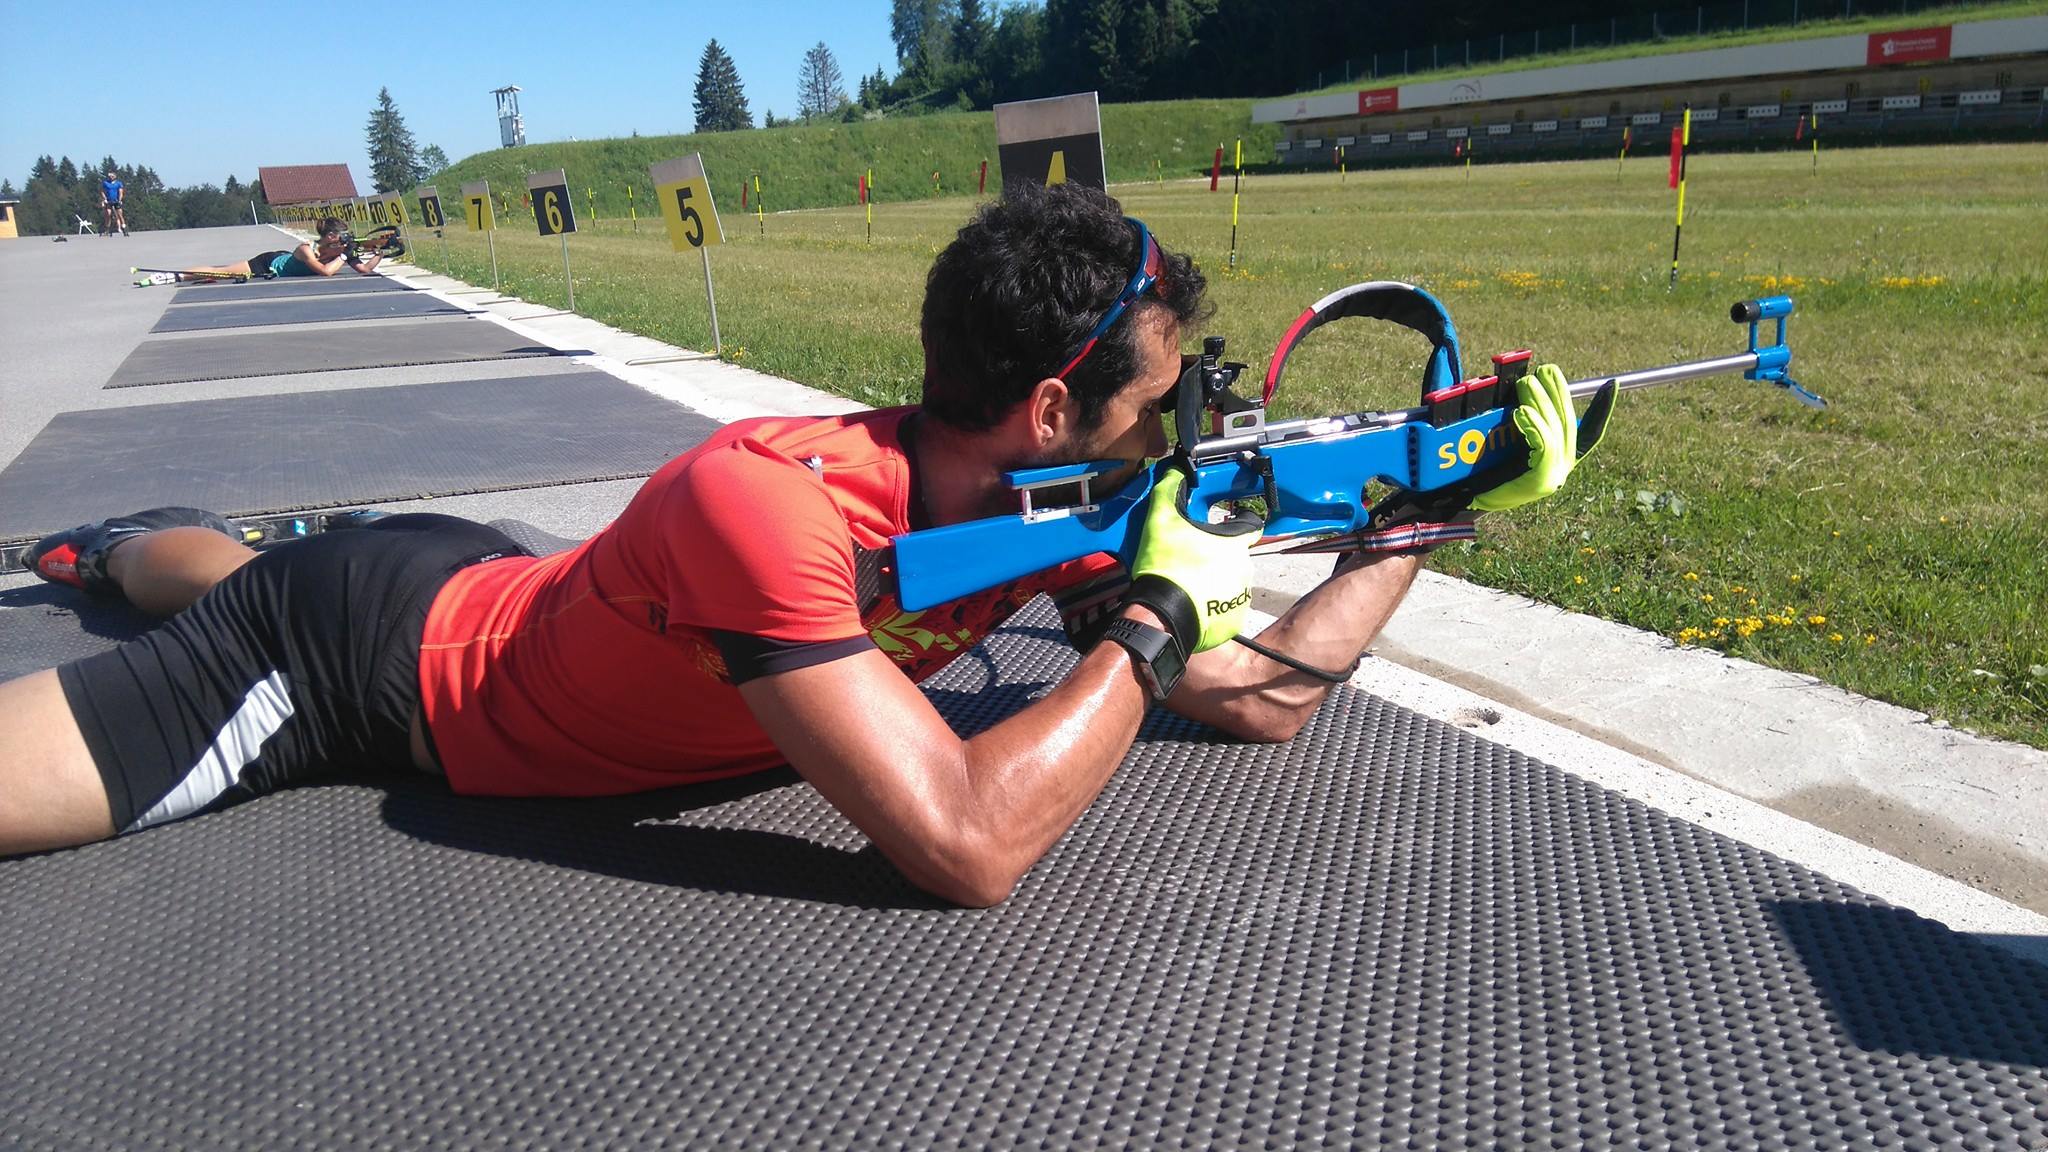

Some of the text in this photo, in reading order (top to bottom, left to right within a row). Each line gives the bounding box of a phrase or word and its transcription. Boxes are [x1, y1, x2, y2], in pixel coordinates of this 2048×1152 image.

[333, 204, 345, 219] 13
[344, 204, 356, 222] 12
[356, 204, 368, 221] 11
[371, 203, 387, 224] 10
[390, 202, 402, 224] 9
[425, 200, 439, 226] 8
[471, 198, 483, 231] 7
[544, 191, 564, 234] 6
[676, 187, 704, 247] 5
[1438, 422, 1520, 470] som
